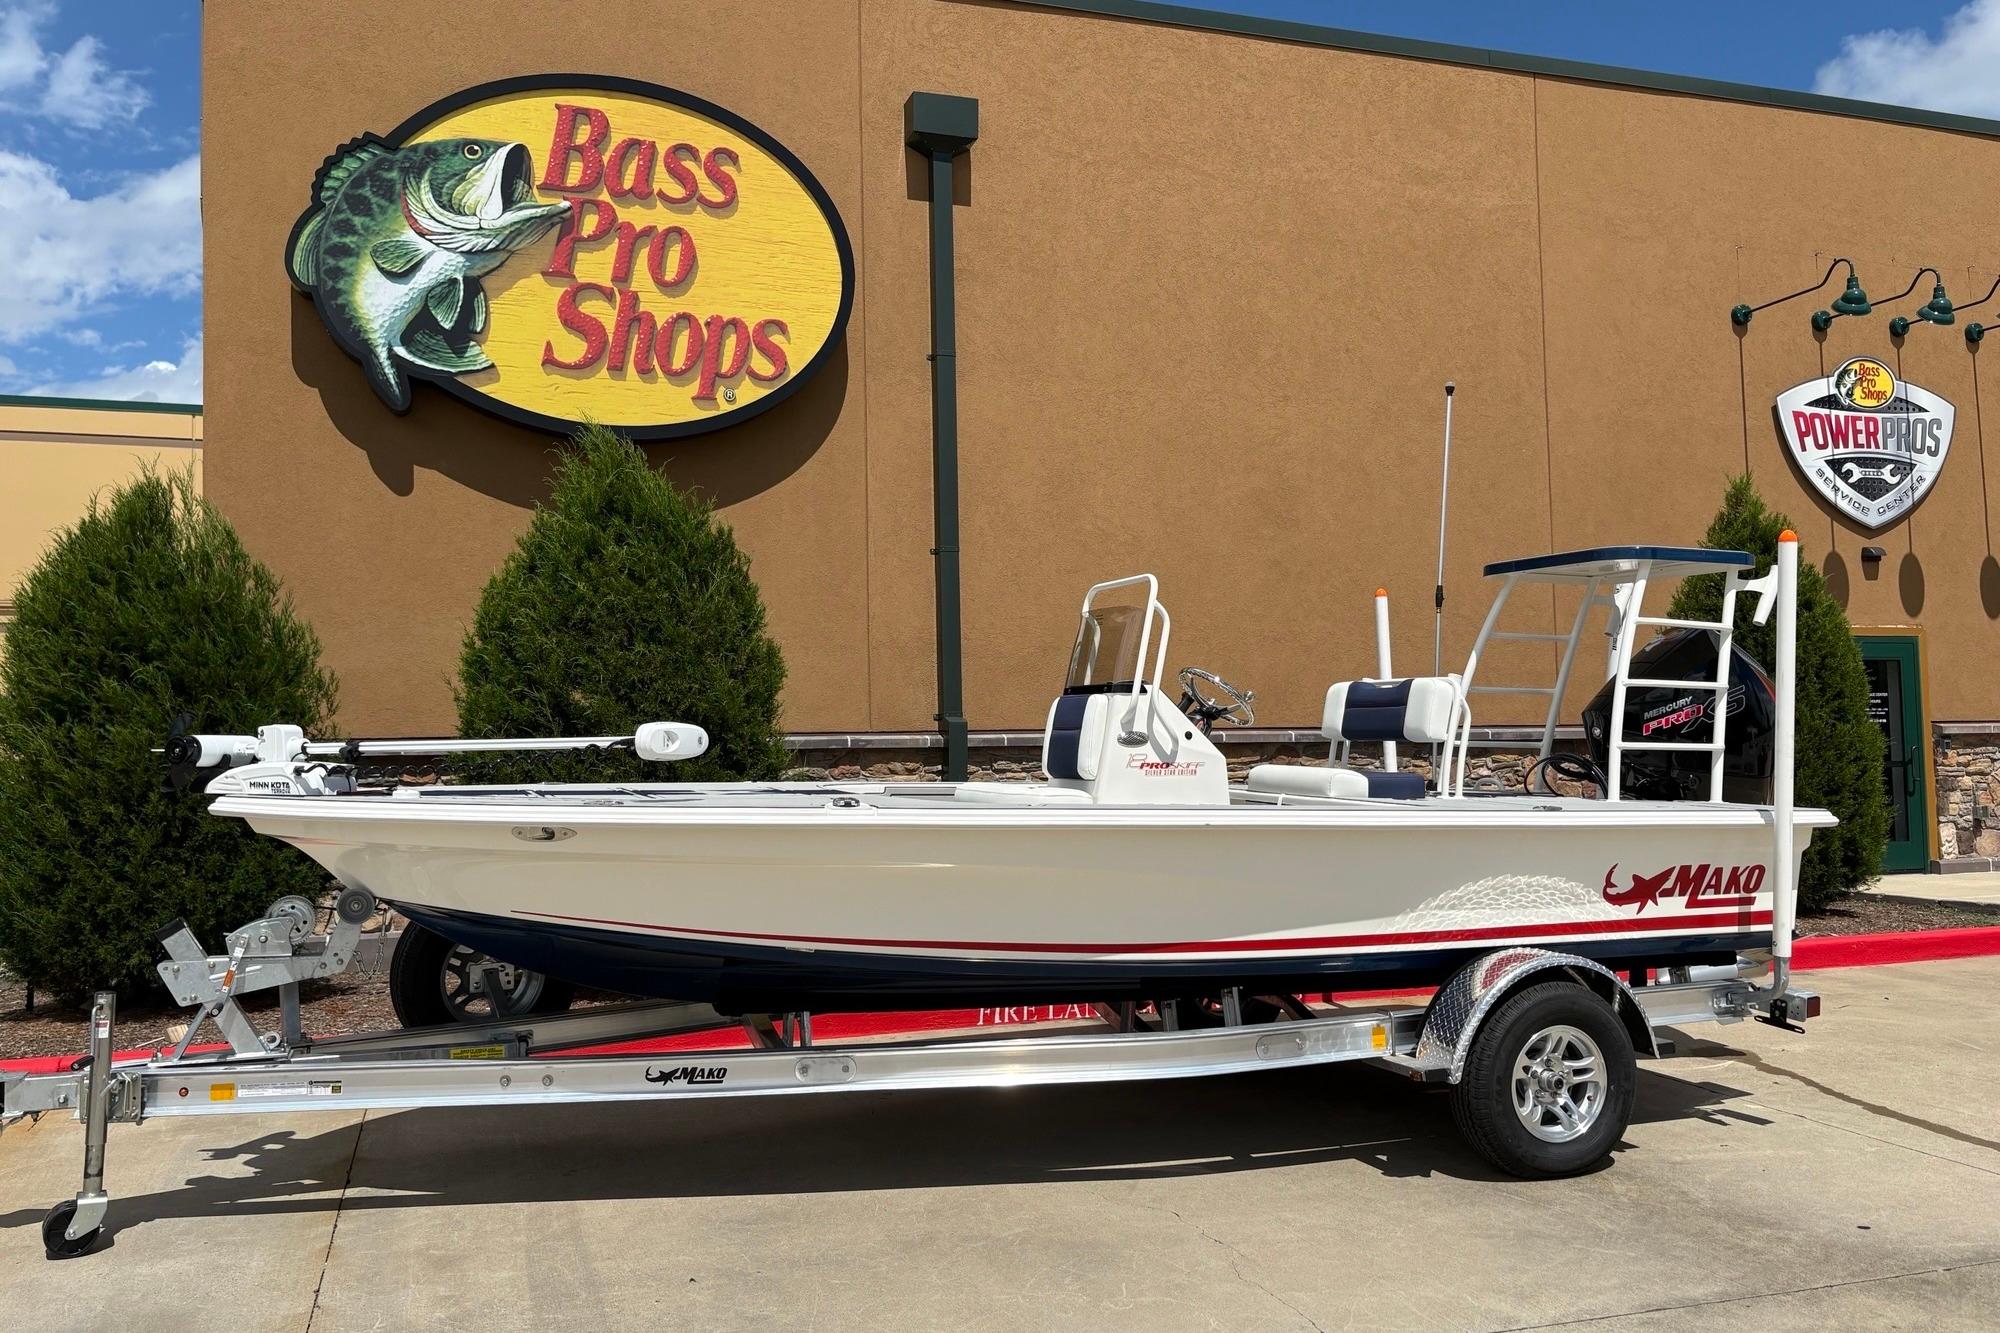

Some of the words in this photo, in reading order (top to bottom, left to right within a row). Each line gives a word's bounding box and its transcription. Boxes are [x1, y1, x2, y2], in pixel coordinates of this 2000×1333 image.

[536, 103, 740, 209] Bass
[541, 195, 697, 288] Pro
[541, 282, 789, 401] Shops
[1859, 363, 1880, 377] Bass
[1860, 375, 1876, 388] Pro
[1860, 387, 1888, 403] Shops
[1815, 468, 1870, 516] SERVICE
[1877, 475, 1926, 515] CENTER
[1643, 696, 1693, 720] MERCURY
[270, 781, 290, 789] KOTA
[1659, 864, 1766, 909] MAKO
[977, 1006, 1038, 1026] FIRE
[673, 1066, 728, 1085] MAKO
